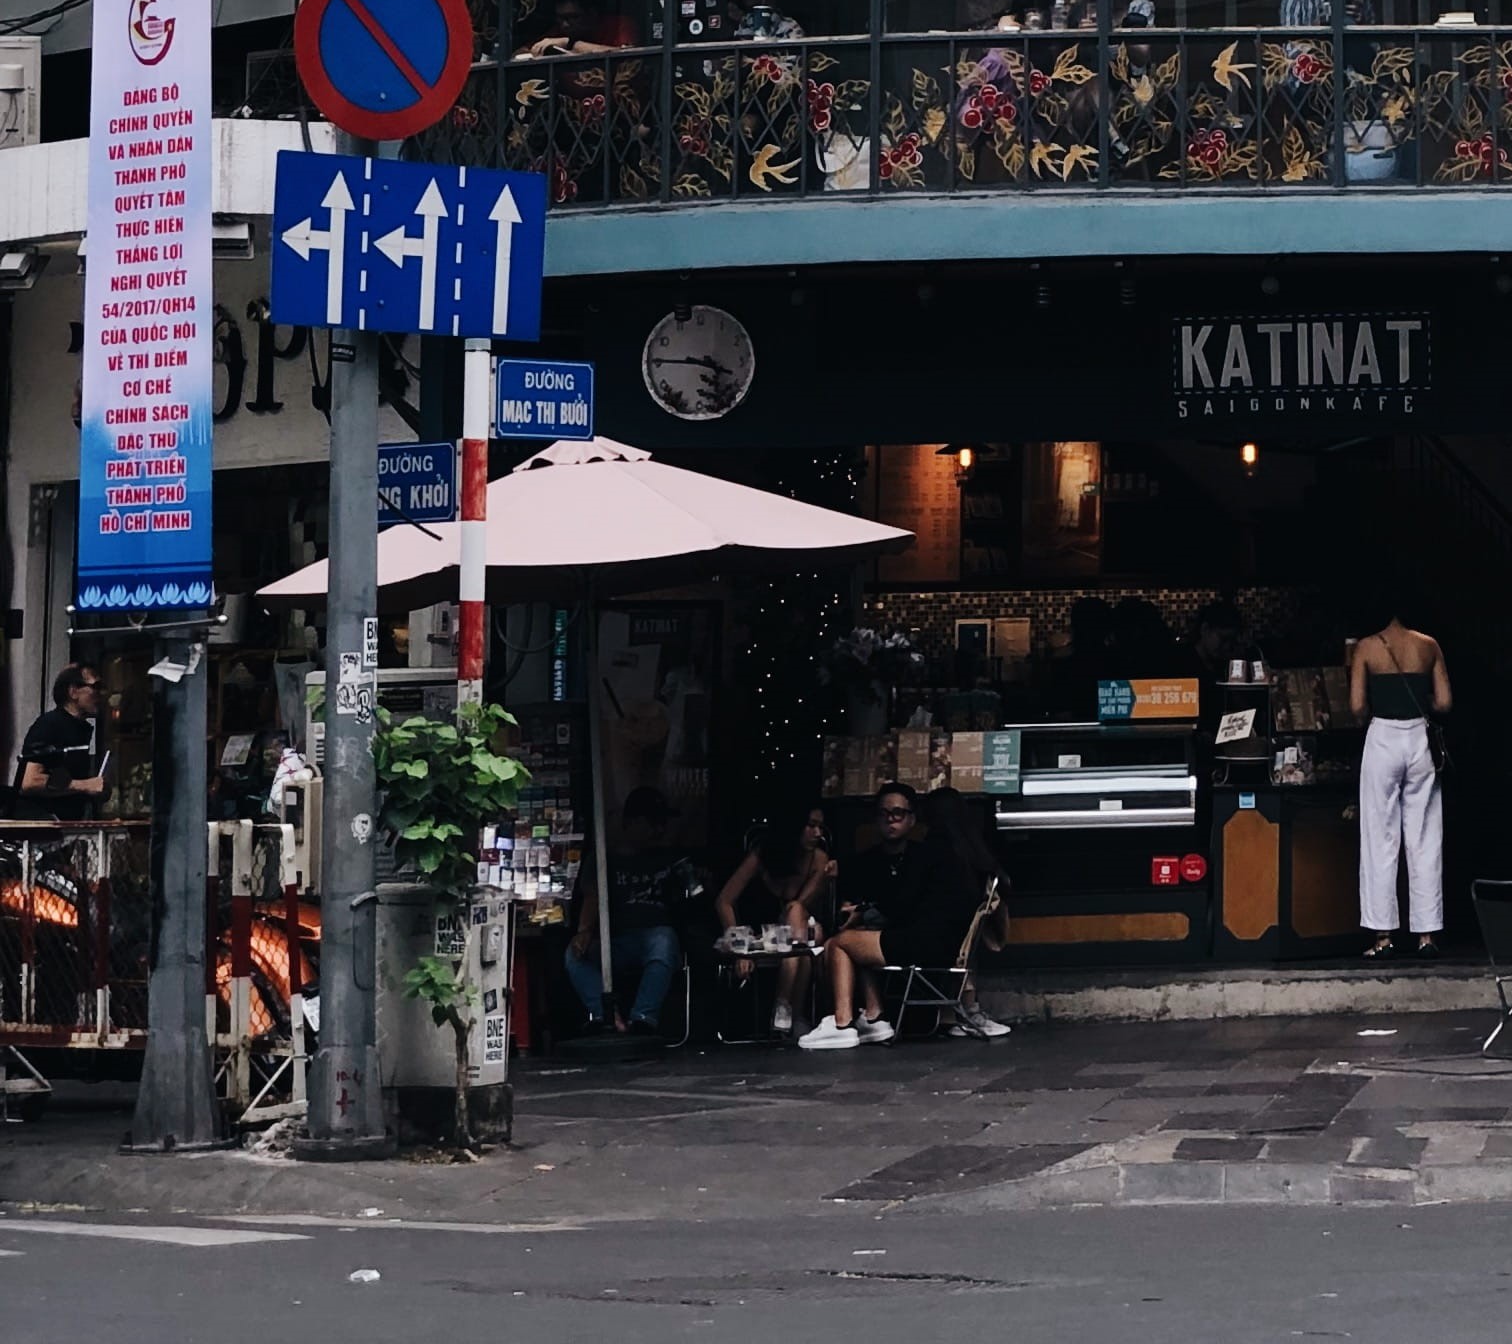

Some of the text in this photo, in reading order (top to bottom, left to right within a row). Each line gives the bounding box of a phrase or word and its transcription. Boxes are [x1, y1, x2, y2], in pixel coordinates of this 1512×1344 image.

[162, 82, 179, 106] BỘ
[102, 296, 196, 319] 54/2017/QH14
[1181, 320, 1423, 389] KATINAT
[525, 368, 575, 391] ĐƯỜNG
[502, 392, 588, 430] MẠC THỊ BƯỞI
[378, 451, 433, 475] ĐƯỜNG
[410, 473, 449, 509] KHỞI
[152, 511, 191, 530] MINH
[486, 1017, 505, 1038] BNE
